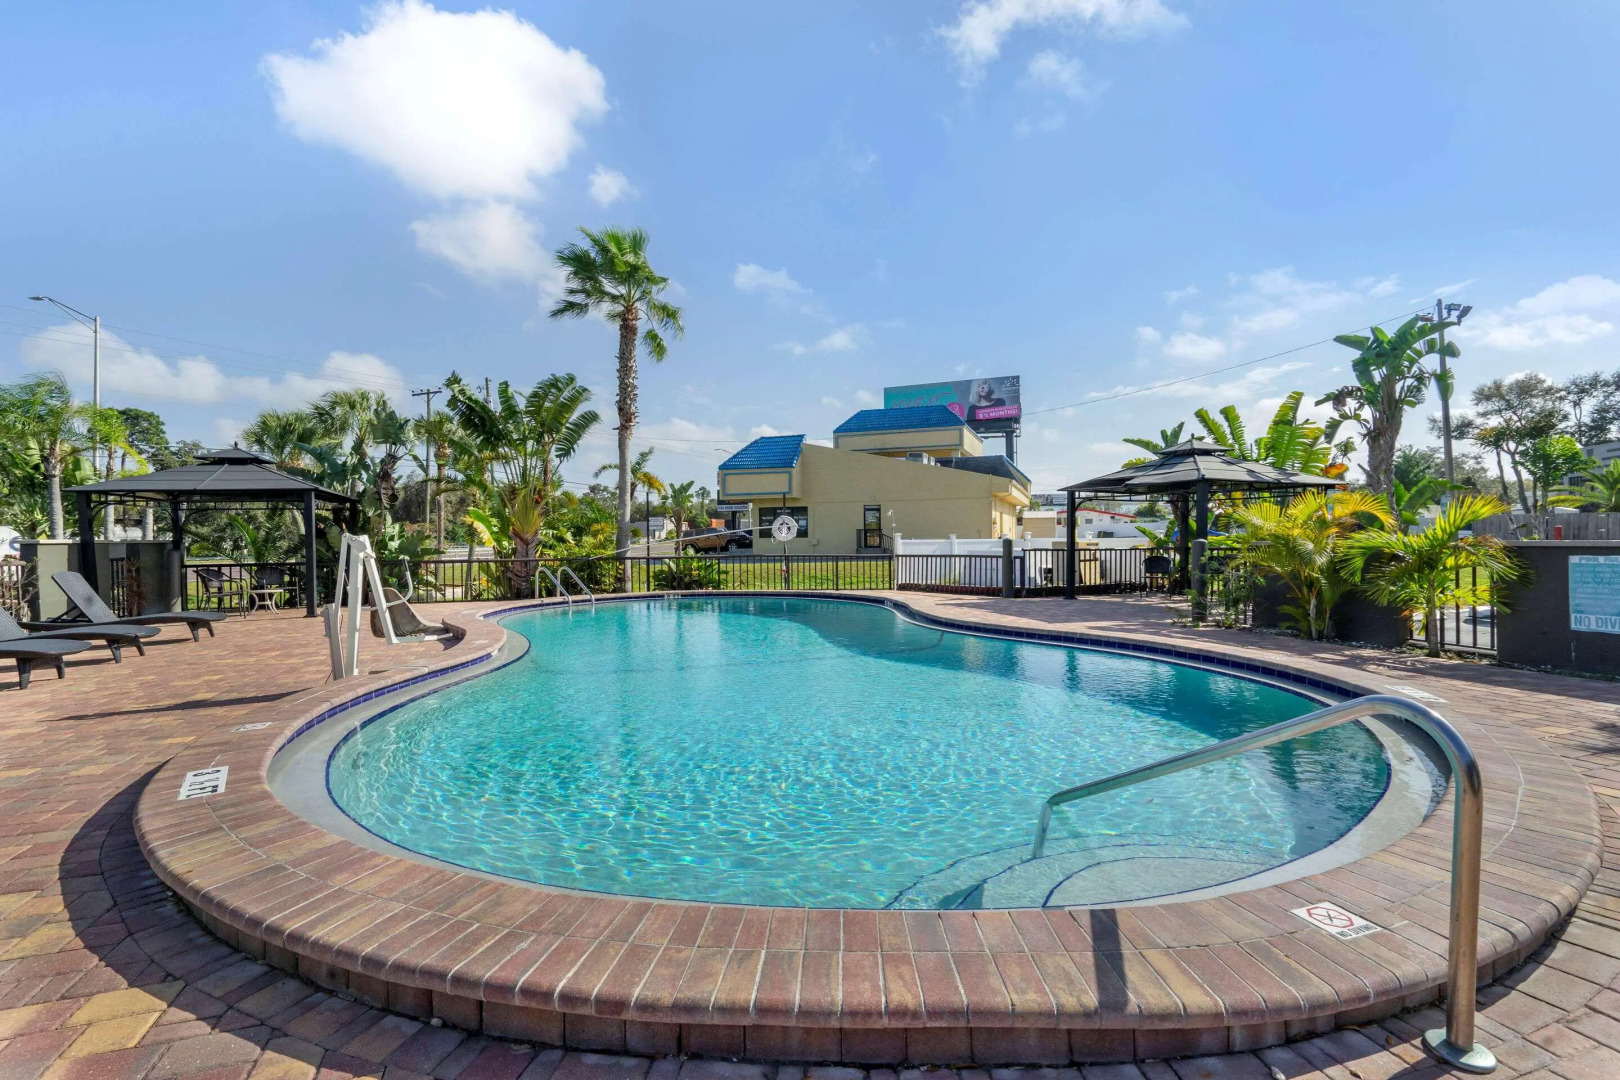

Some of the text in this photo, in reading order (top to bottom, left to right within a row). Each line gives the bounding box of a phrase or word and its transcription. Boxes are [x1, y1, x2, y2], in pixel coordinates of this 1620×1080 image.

[990, 409, 1018, 417] MONTHS!
[1574, 615, 1620, 630] NO DIV
[1335, 923, 1379, 938] NO DIVING
